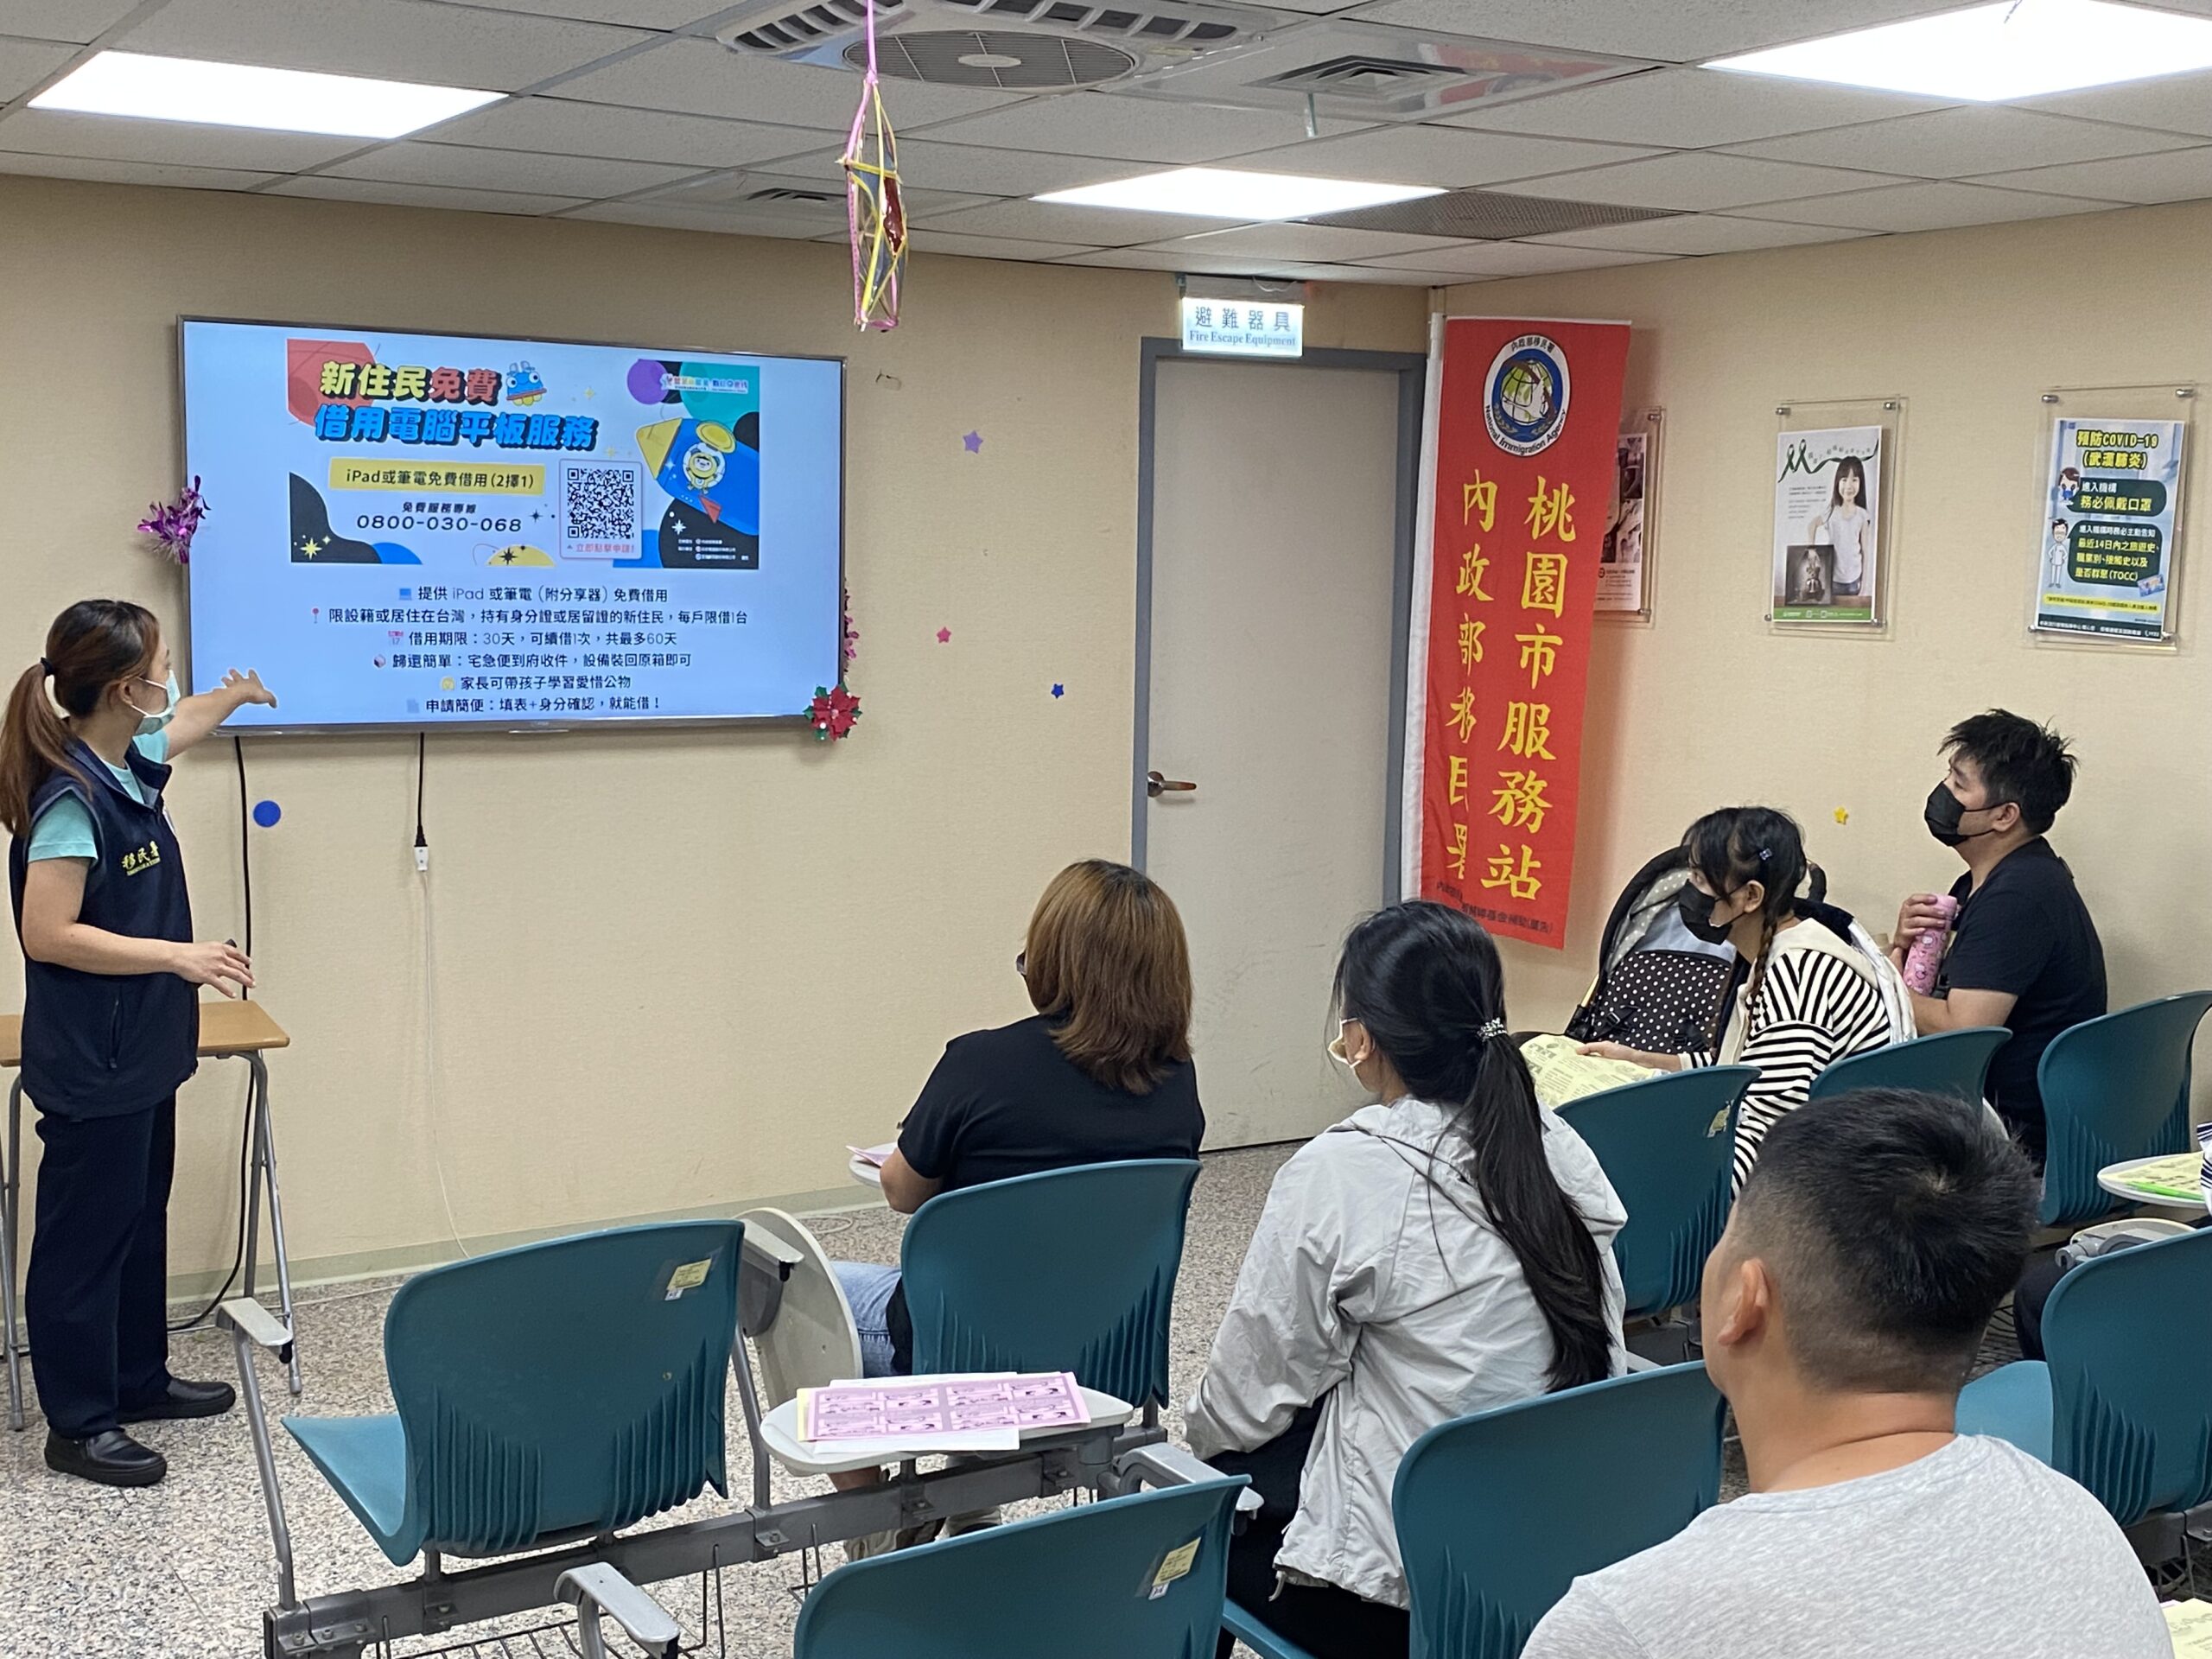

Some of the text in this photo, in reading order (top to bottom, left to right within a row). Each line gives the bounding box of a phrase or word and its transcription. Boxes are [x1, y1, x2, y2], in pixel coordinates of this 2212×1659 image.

[1195, 306, 1290, 332] 避難器具
[1190, 330, 1295, 348] Fire Escape Equipment
[321, 360, 501, 405] 新住民免費
[315, 404, 598, 450] 借用電腦平板服務
[2076, 429, 2158, 448] 預防COVID-19
[346, 469, 534, 489] iPad或筆電免費借用(2擇1)
[357, 515, 522, 532] 0800-030-068
[418, 587, 448, 601] 提供
[453, 588, 484, 600] iPad
[461, 675, 631, 690] 家長可帶孩子學習愛惜公物
[1479, 475, 1576, 900] 桃園市服務站
